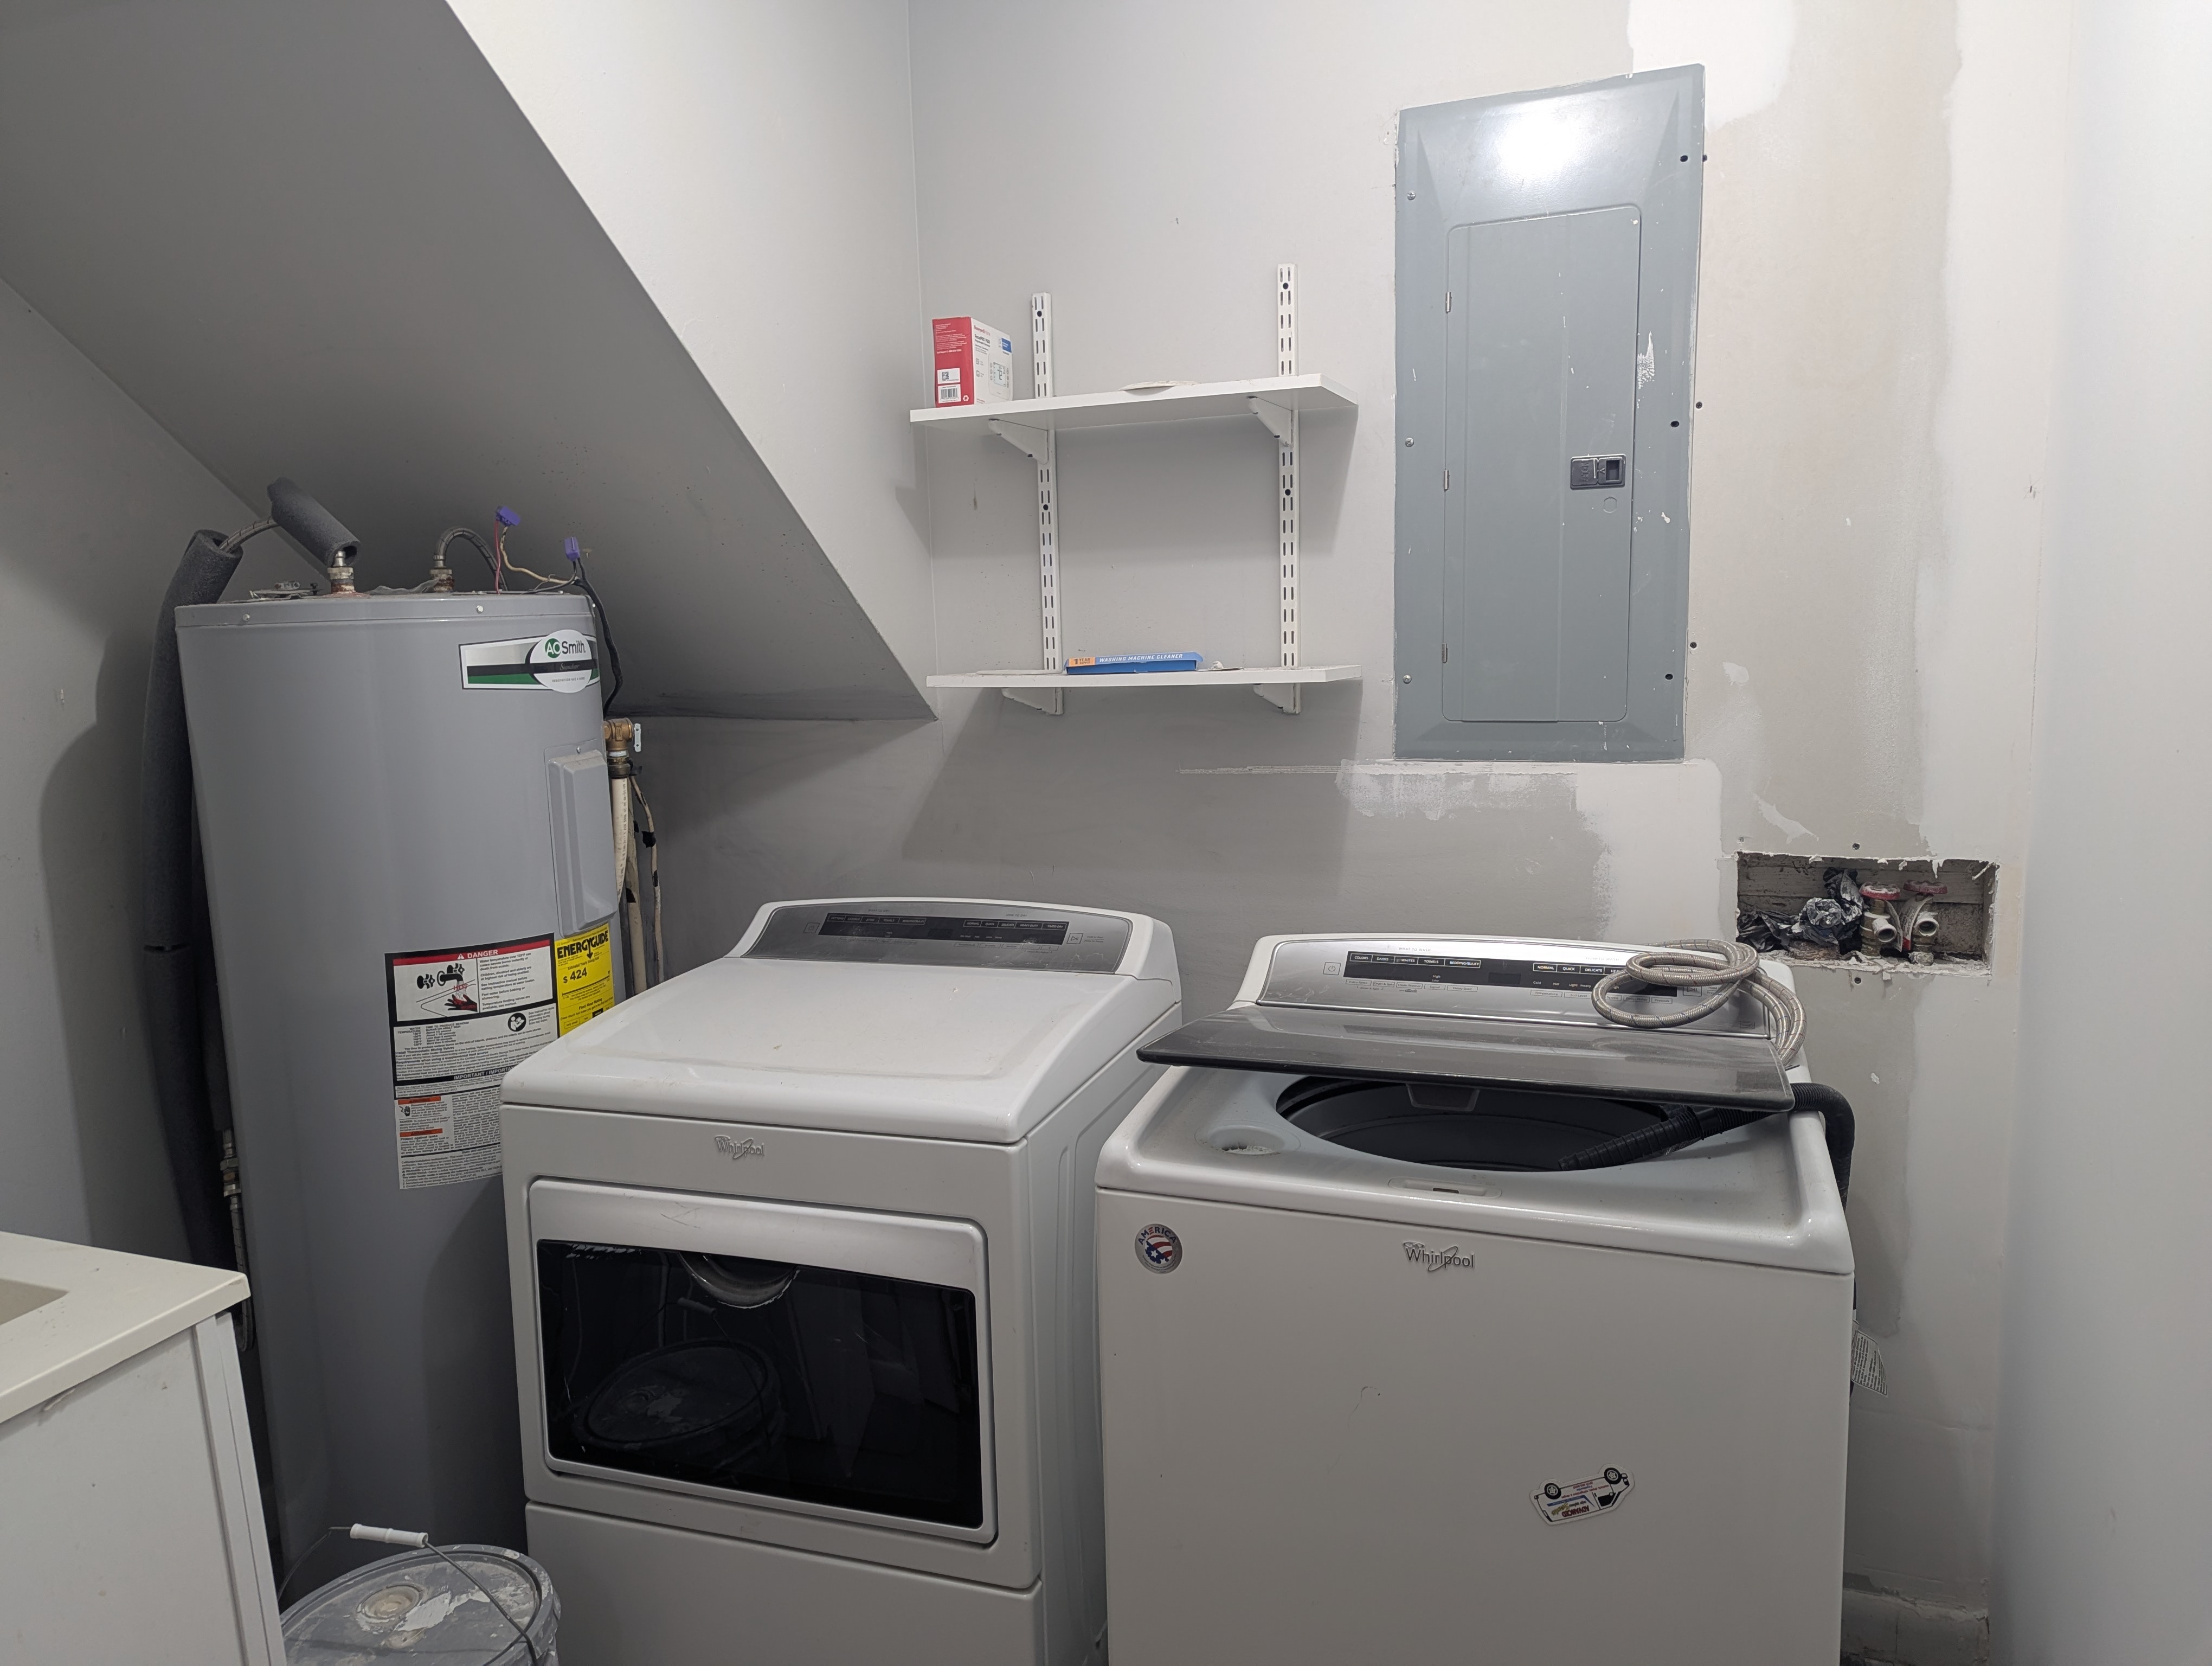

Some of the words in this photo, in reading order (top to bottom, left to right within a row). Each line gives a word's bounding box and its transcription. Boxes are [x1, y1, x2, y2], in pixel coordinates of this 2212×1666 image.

[562, 640, 586, 654] Smith
[557, 930, 608, 959] ENERGYGUIDE
[467, 949, 498, 959] DANGER
[570, 967, 587, 981] 424
[454, 1071, 485, 1080] IMPORTANT
[715, 1138, 765, 1158] Whirlpool
[1138, 1226, 1176, 1245] AMERICA
[1404, 1245, 1474, 1271] Whirlpool
[1561, 1505, 1589, 1517] ADVANCED
